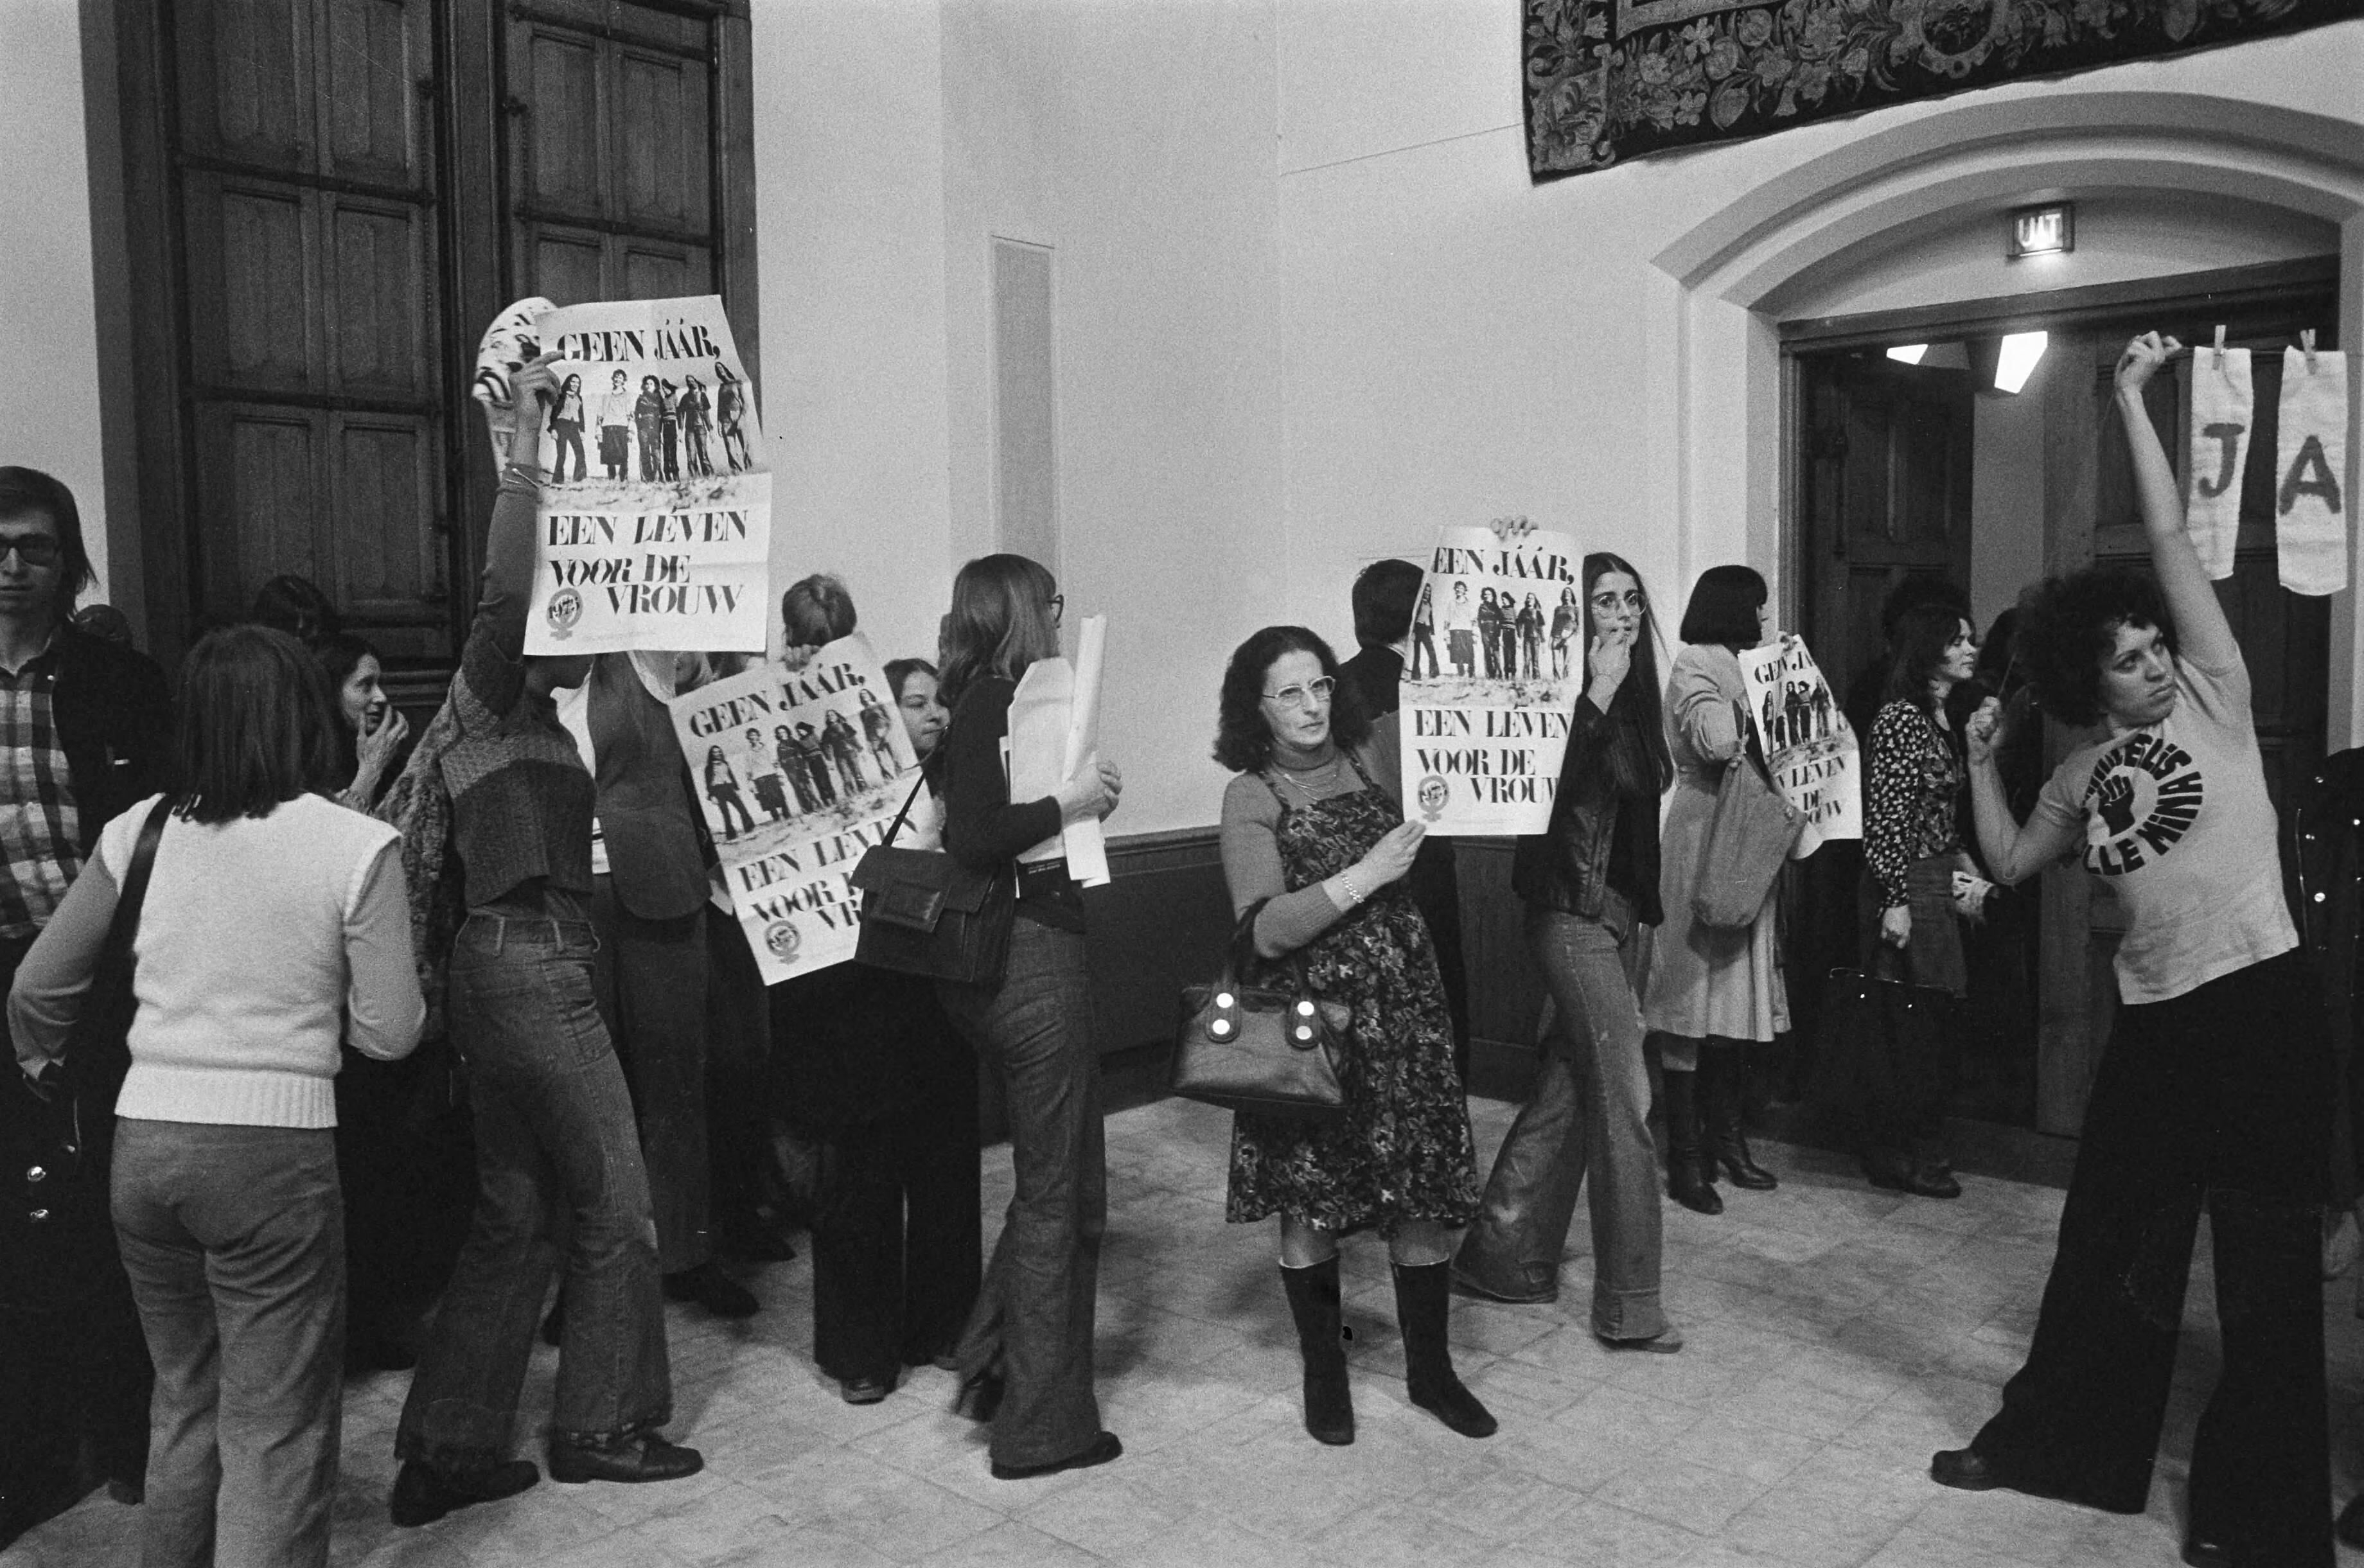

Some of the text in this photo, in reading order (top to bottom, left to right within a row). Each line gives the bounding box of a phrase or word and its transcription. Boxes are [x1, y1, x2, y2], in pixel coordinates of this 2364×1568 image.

[558, 330, 644, 361] GEEN
[548, 510, 748, 545] EEN LEVEN
[548, 554, 691, 587] VOOR DE
[1431, 547, 1484, 574] EEN
[606, 585, 743, 614] VROUW
[690, 691, 771, 737] GEEN
[1415, 710, 1571, 738] EEN LEVEN
[1416, 749, 1536, 775] VOOR DE
[739, 849, 800, 892] EEN
[752, 880, 836, 922] VOOR
